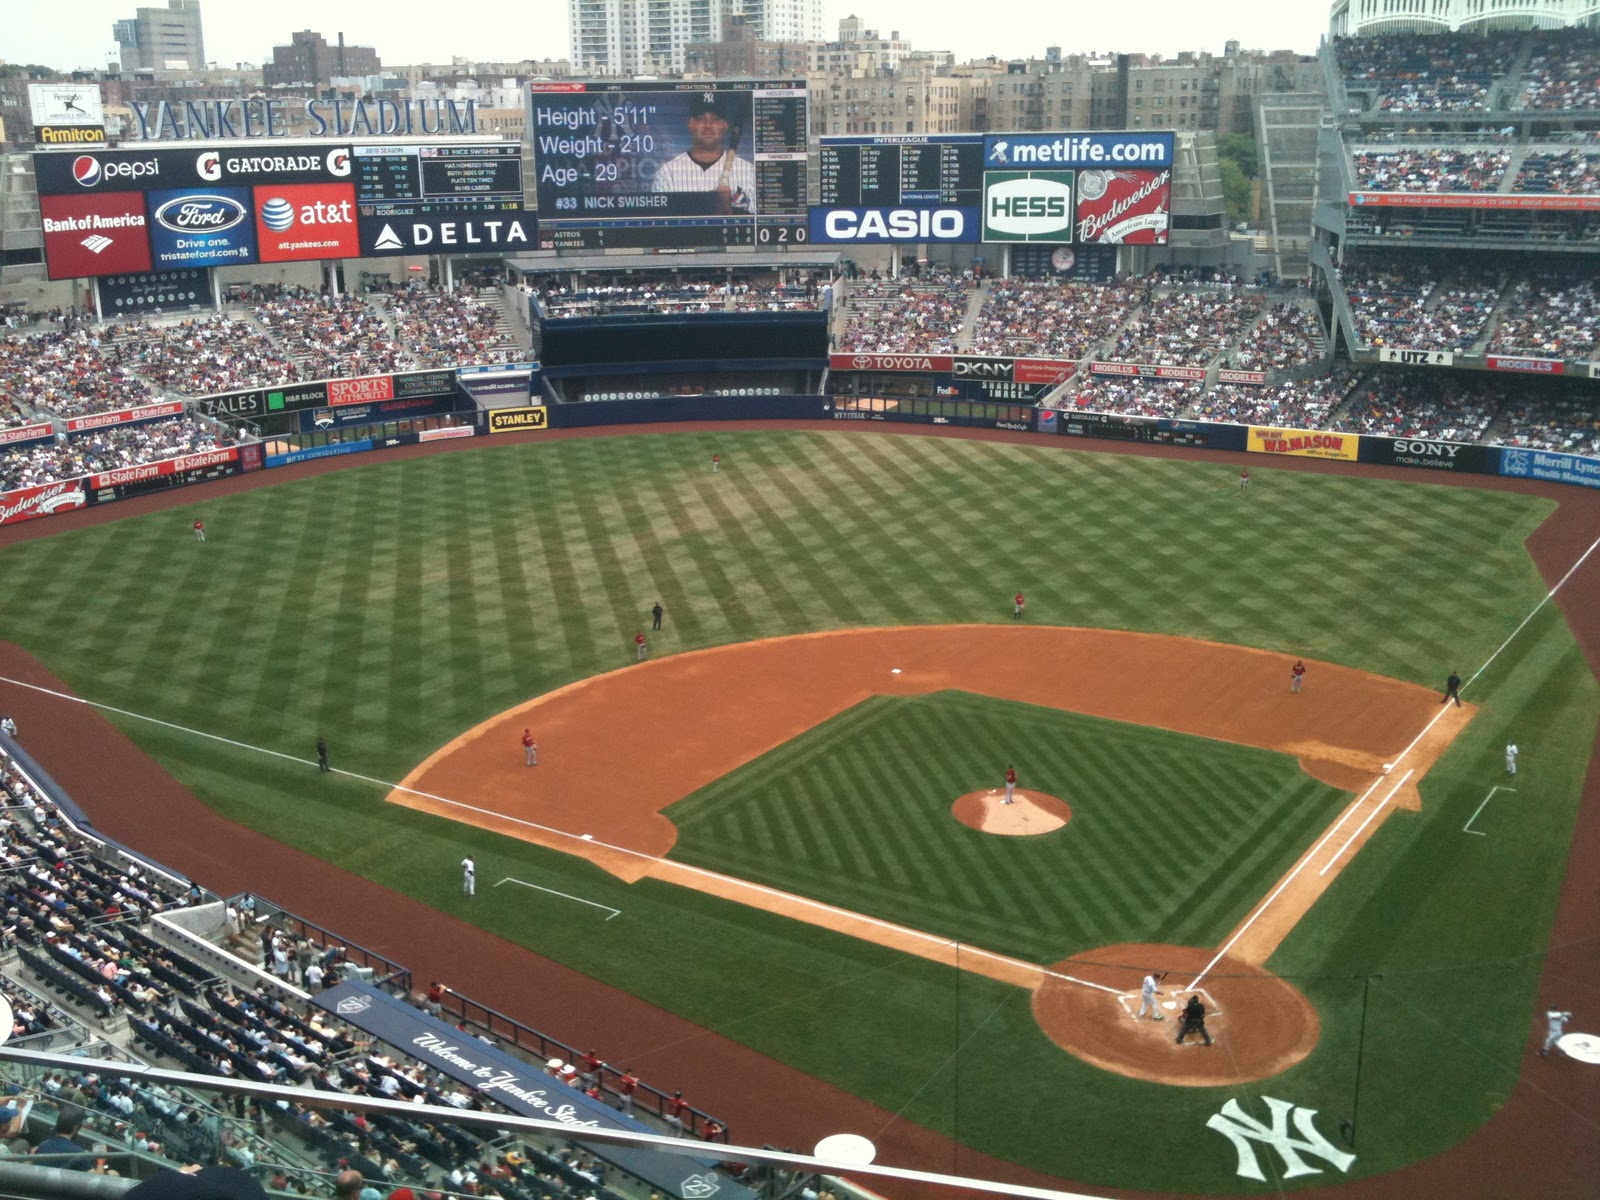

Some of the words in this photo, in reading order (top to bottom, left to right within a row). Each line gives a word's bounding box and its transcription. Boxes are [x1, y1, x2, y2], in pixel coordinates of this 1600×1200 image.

[124, 100, 286, 140] YANKEE
[304, 98, 477, 137] STADIUM
[537, 107, 596, 129] Height
[614, 106, 656, 124] 5'11"
[42, 127, 104, 142] Armitron
[539, 136, 603, 158] Weight
[620, 135, 654, 152] 210
[1013, 138, 1166, 162] metlife.com
[104, 158, 159, 180] pepsi
[227, 156, 321, 173] GATORADE
[542, 164, 577, 186] Age
[595, 164, 618, 180] 29
[556, 197, 577, 209] #33
[584, 197, 615, 209] NICK
[618, 196, 668, 208] SWISHER
[991, 197, 1065, 218] HESS
[1076, 170, 1170, 242] Budweiser
[177, 204, 225, 226] Ford
[300, 200, 352, 225] at&t
[44, 216, 77, 232] Bank
[78, 215, 92, 229] of
[93, 213, 145, 228] America
[825, 209, 964, 239] CASIO
[1112, 219, 1143, 238] American
[413, 221, 527, 246] DELTA
[760, 228, 770, 242] 0
[778, 228, 787, 242] 2
[796, 228, 806, 242] 0
[177, 239, 205, 248] Drive
[278, 240, 339, 251] att.yankees.com
[160, 250, 238, 261] tristateford.com
[874, 357, 932, 369] TOYOTA
[1401, 351, 1428, 364] UTZ
[954, 362, 1013, 376] DKNY
[1094, 364, 1133, 374] MODELL'S
[1160, 368, 1201, 378] MODELL'S
[1220, 372, 1263, 382] MODELL'S
[332, 378, 388, 395] SPORTS
[937, 386, 959, 395] FedEx
[982, 382, 1030, 392] SHARPER
[208, 395, 257, 415] ZALES
[286, 393, 301, 402] H&R
[302, 391, 324, 400] BLOCK
[333, 391, 389, 403] AUTHORITY
[496, 413, 540, 426] STANLEY
[1394, 440, 1460, 457] SONY
[185, 456, 208, 468] State
[208, 451, 229, 463] Farm
[1534, 454, 1572, 469] Merrill
[111, 470, 134, 483] State
[135, 466, 158, 479] Farm
[412, 1032, 474, 1071] Welcome
[472, 1065, 493, 1078] to
[477, 1070, 548, 1108] Yankee
[1206, 1095, 1356, 1182] NY
